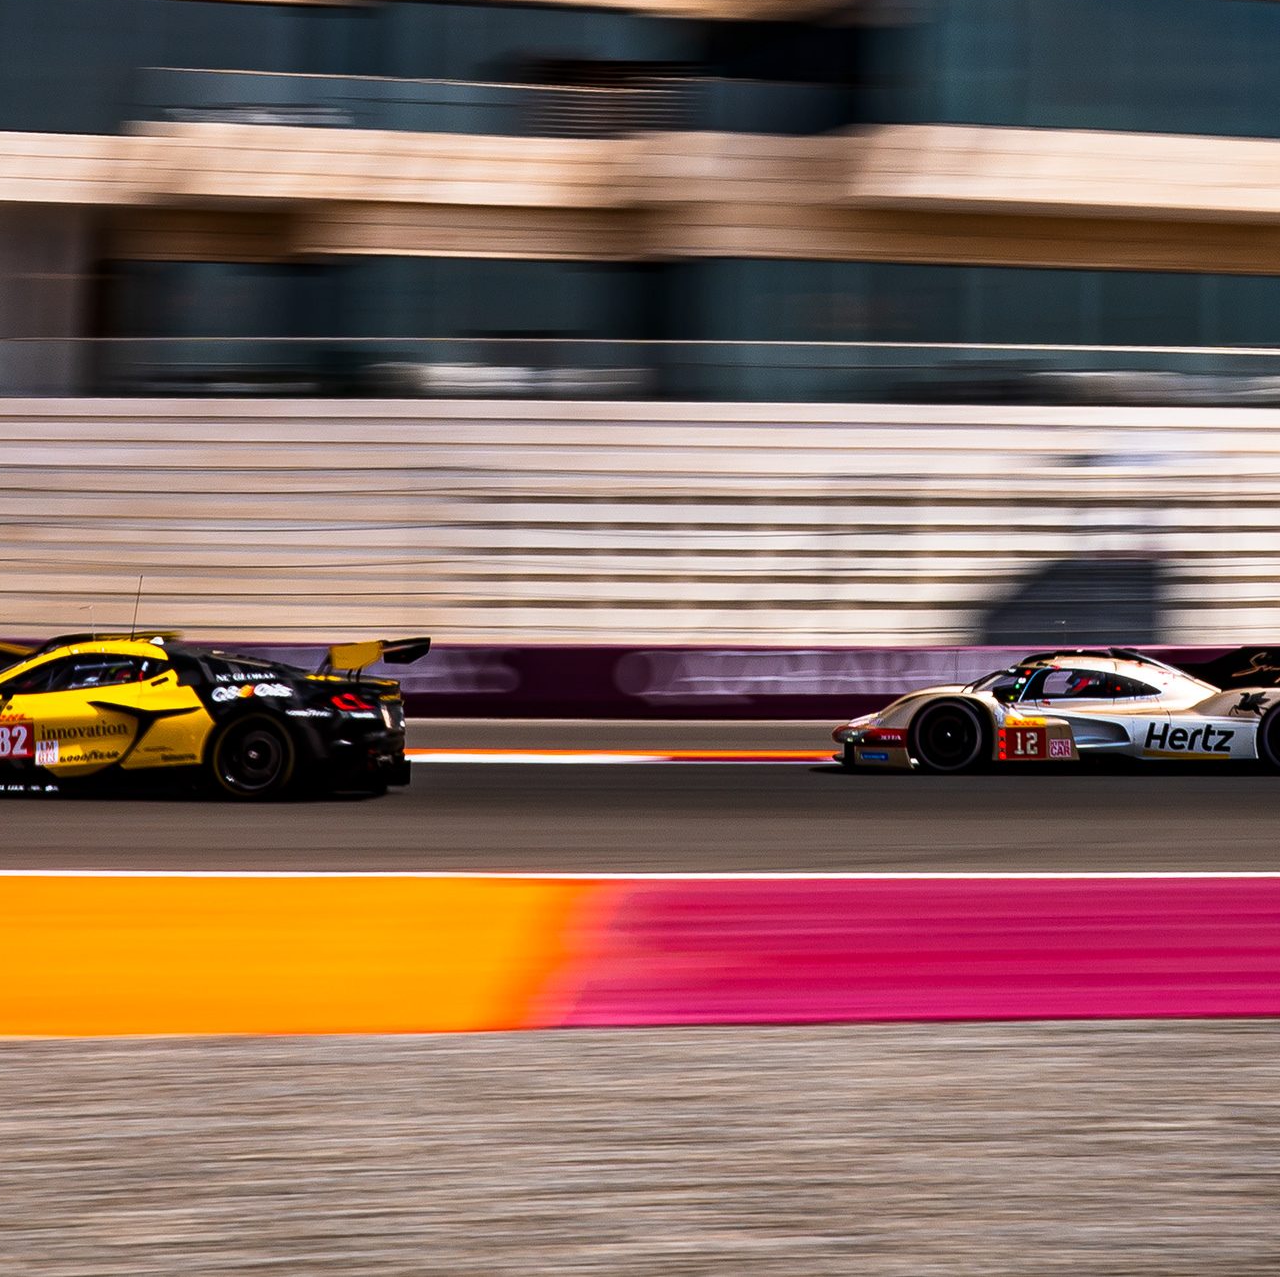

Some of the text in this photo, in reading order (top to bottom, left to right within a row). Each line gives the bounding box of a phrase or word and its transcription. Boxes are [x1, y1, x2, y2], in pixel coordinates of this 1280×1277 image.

[41, 720, 128, 740] innovation
[1144, 723, 1235, 752] Hertz
[1014, 731, 1038, 755] 12
[1051, 745, 1071, 757] CAR
